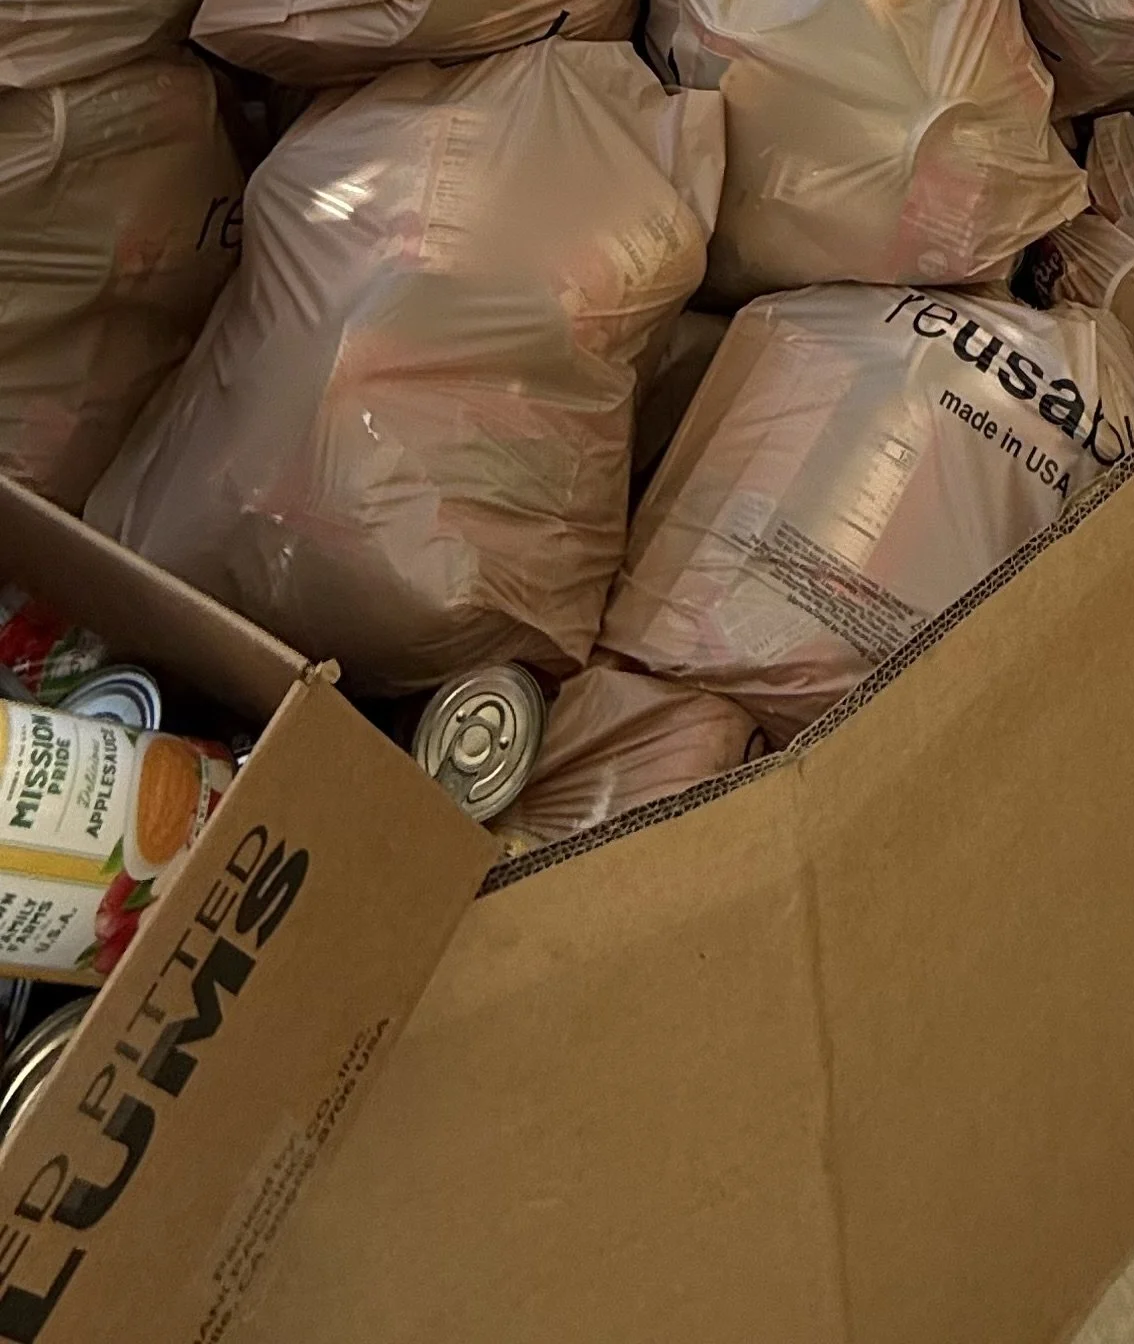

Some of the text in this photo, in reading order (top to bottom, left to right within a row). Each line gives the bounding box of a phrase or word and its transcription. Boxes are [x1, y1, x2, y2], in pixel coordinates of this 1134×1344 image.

[938, 389, 1072, 498] made in USA
[9, 713, 55, 829] MISSION
[47, 737, 71, 795] PRIDE
[7, 900, 53, 952] FARMS
[77, 823, 270, 1123] PITTED
